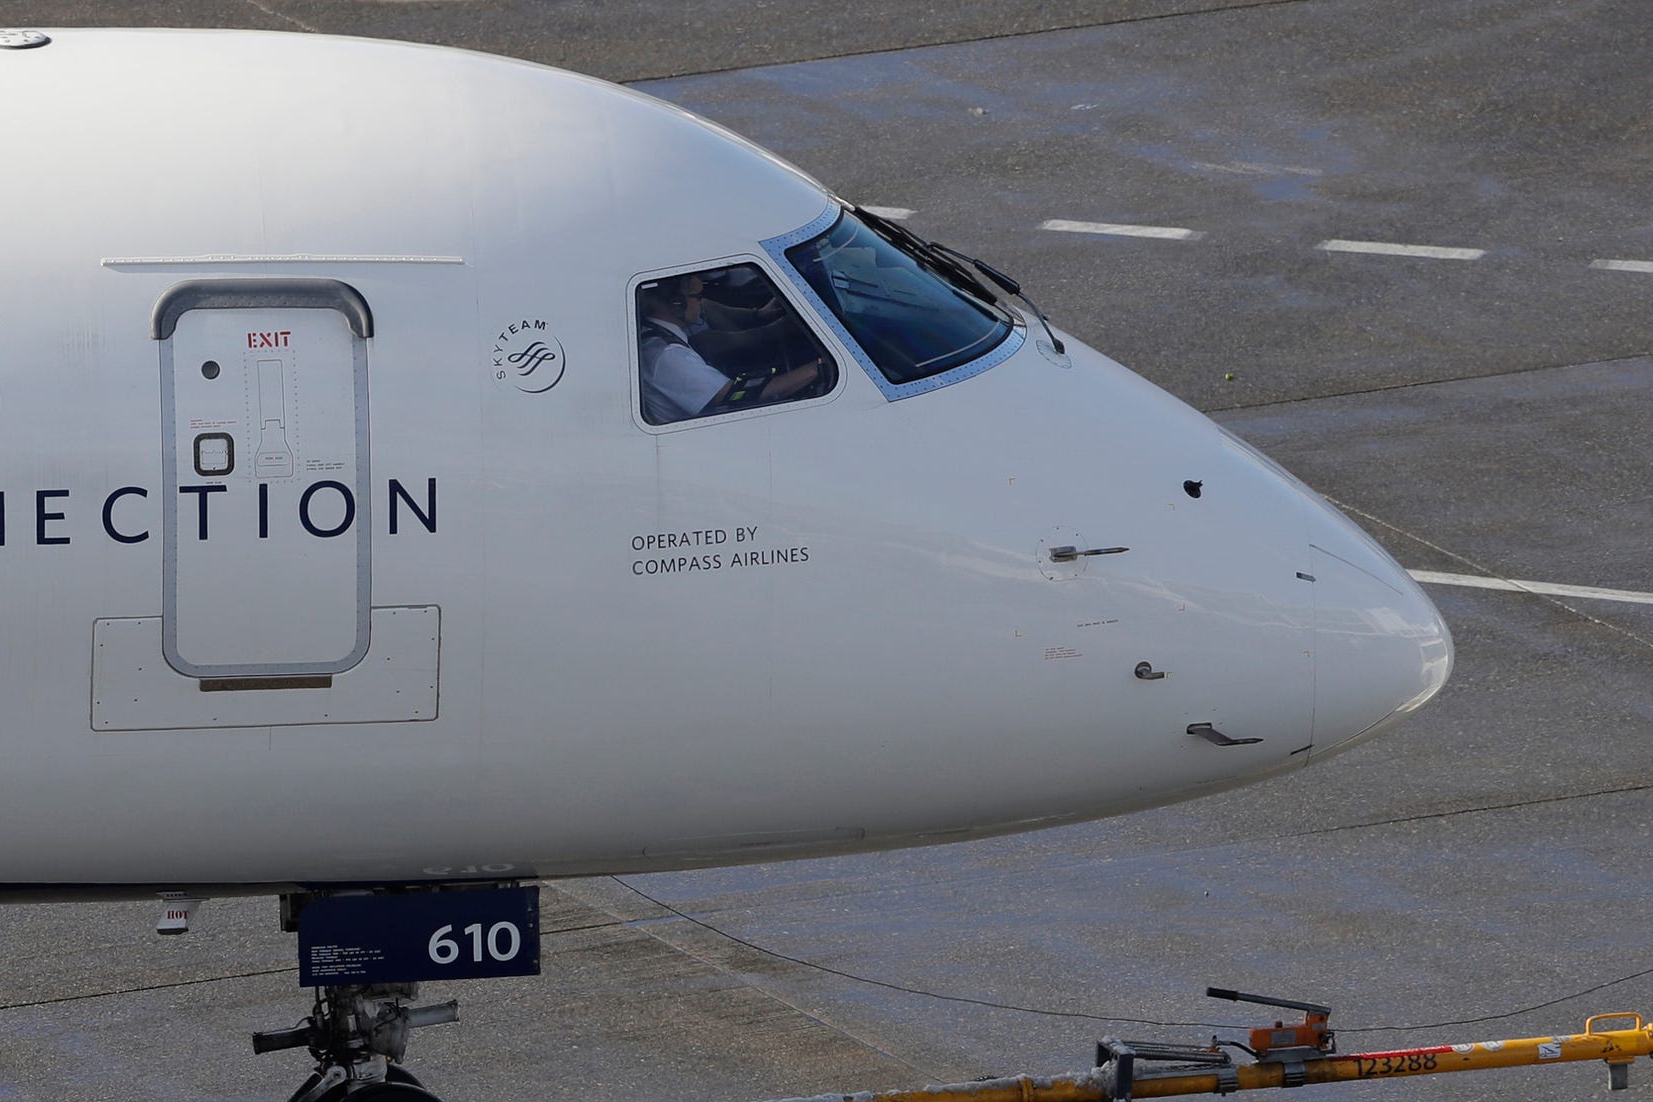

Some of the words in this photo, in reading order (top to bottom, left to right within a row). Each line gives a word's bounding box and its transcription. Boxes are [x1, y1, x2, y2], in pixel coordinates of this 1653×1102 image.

[247, 331, 291, 348] EXIT
[493, 319, 546, 380] SKYTEAM
[631, 530, 727, 551] OPERATED
[736, 526, 758, 543] BY
[632, 555, 722, 576] COMPASS
[730, 547, 809, 568] AIRLINES
[166, 910, 188, 920] HOT
[428, 921, 521, 965] 610
[1353, 1052, 1438, 1077] 123288
